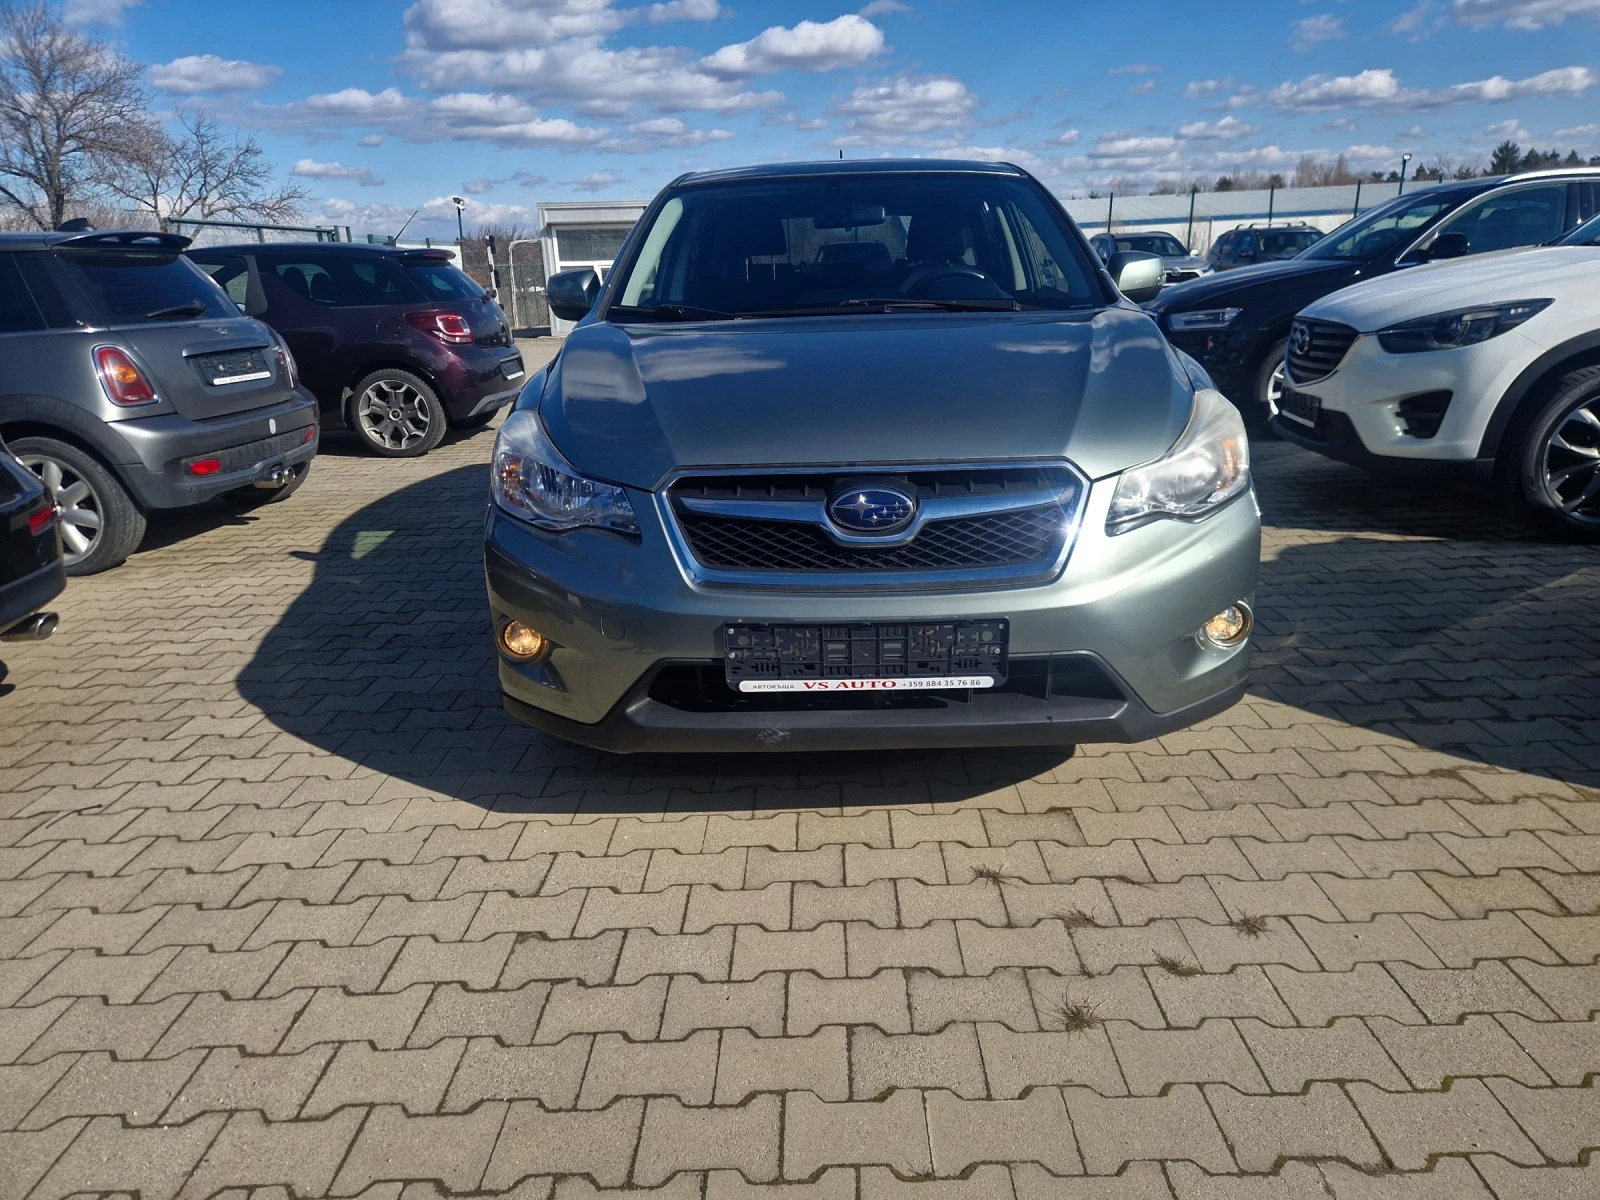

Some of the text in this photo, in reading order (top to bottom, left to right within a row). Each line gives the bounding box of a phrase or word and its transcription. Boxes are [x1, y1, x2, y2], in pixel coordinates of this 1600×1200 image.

[803, 681, 829, 690] VS
[835, 680, 897, 689] AUTO
[902, 680, 924, 688] +359
